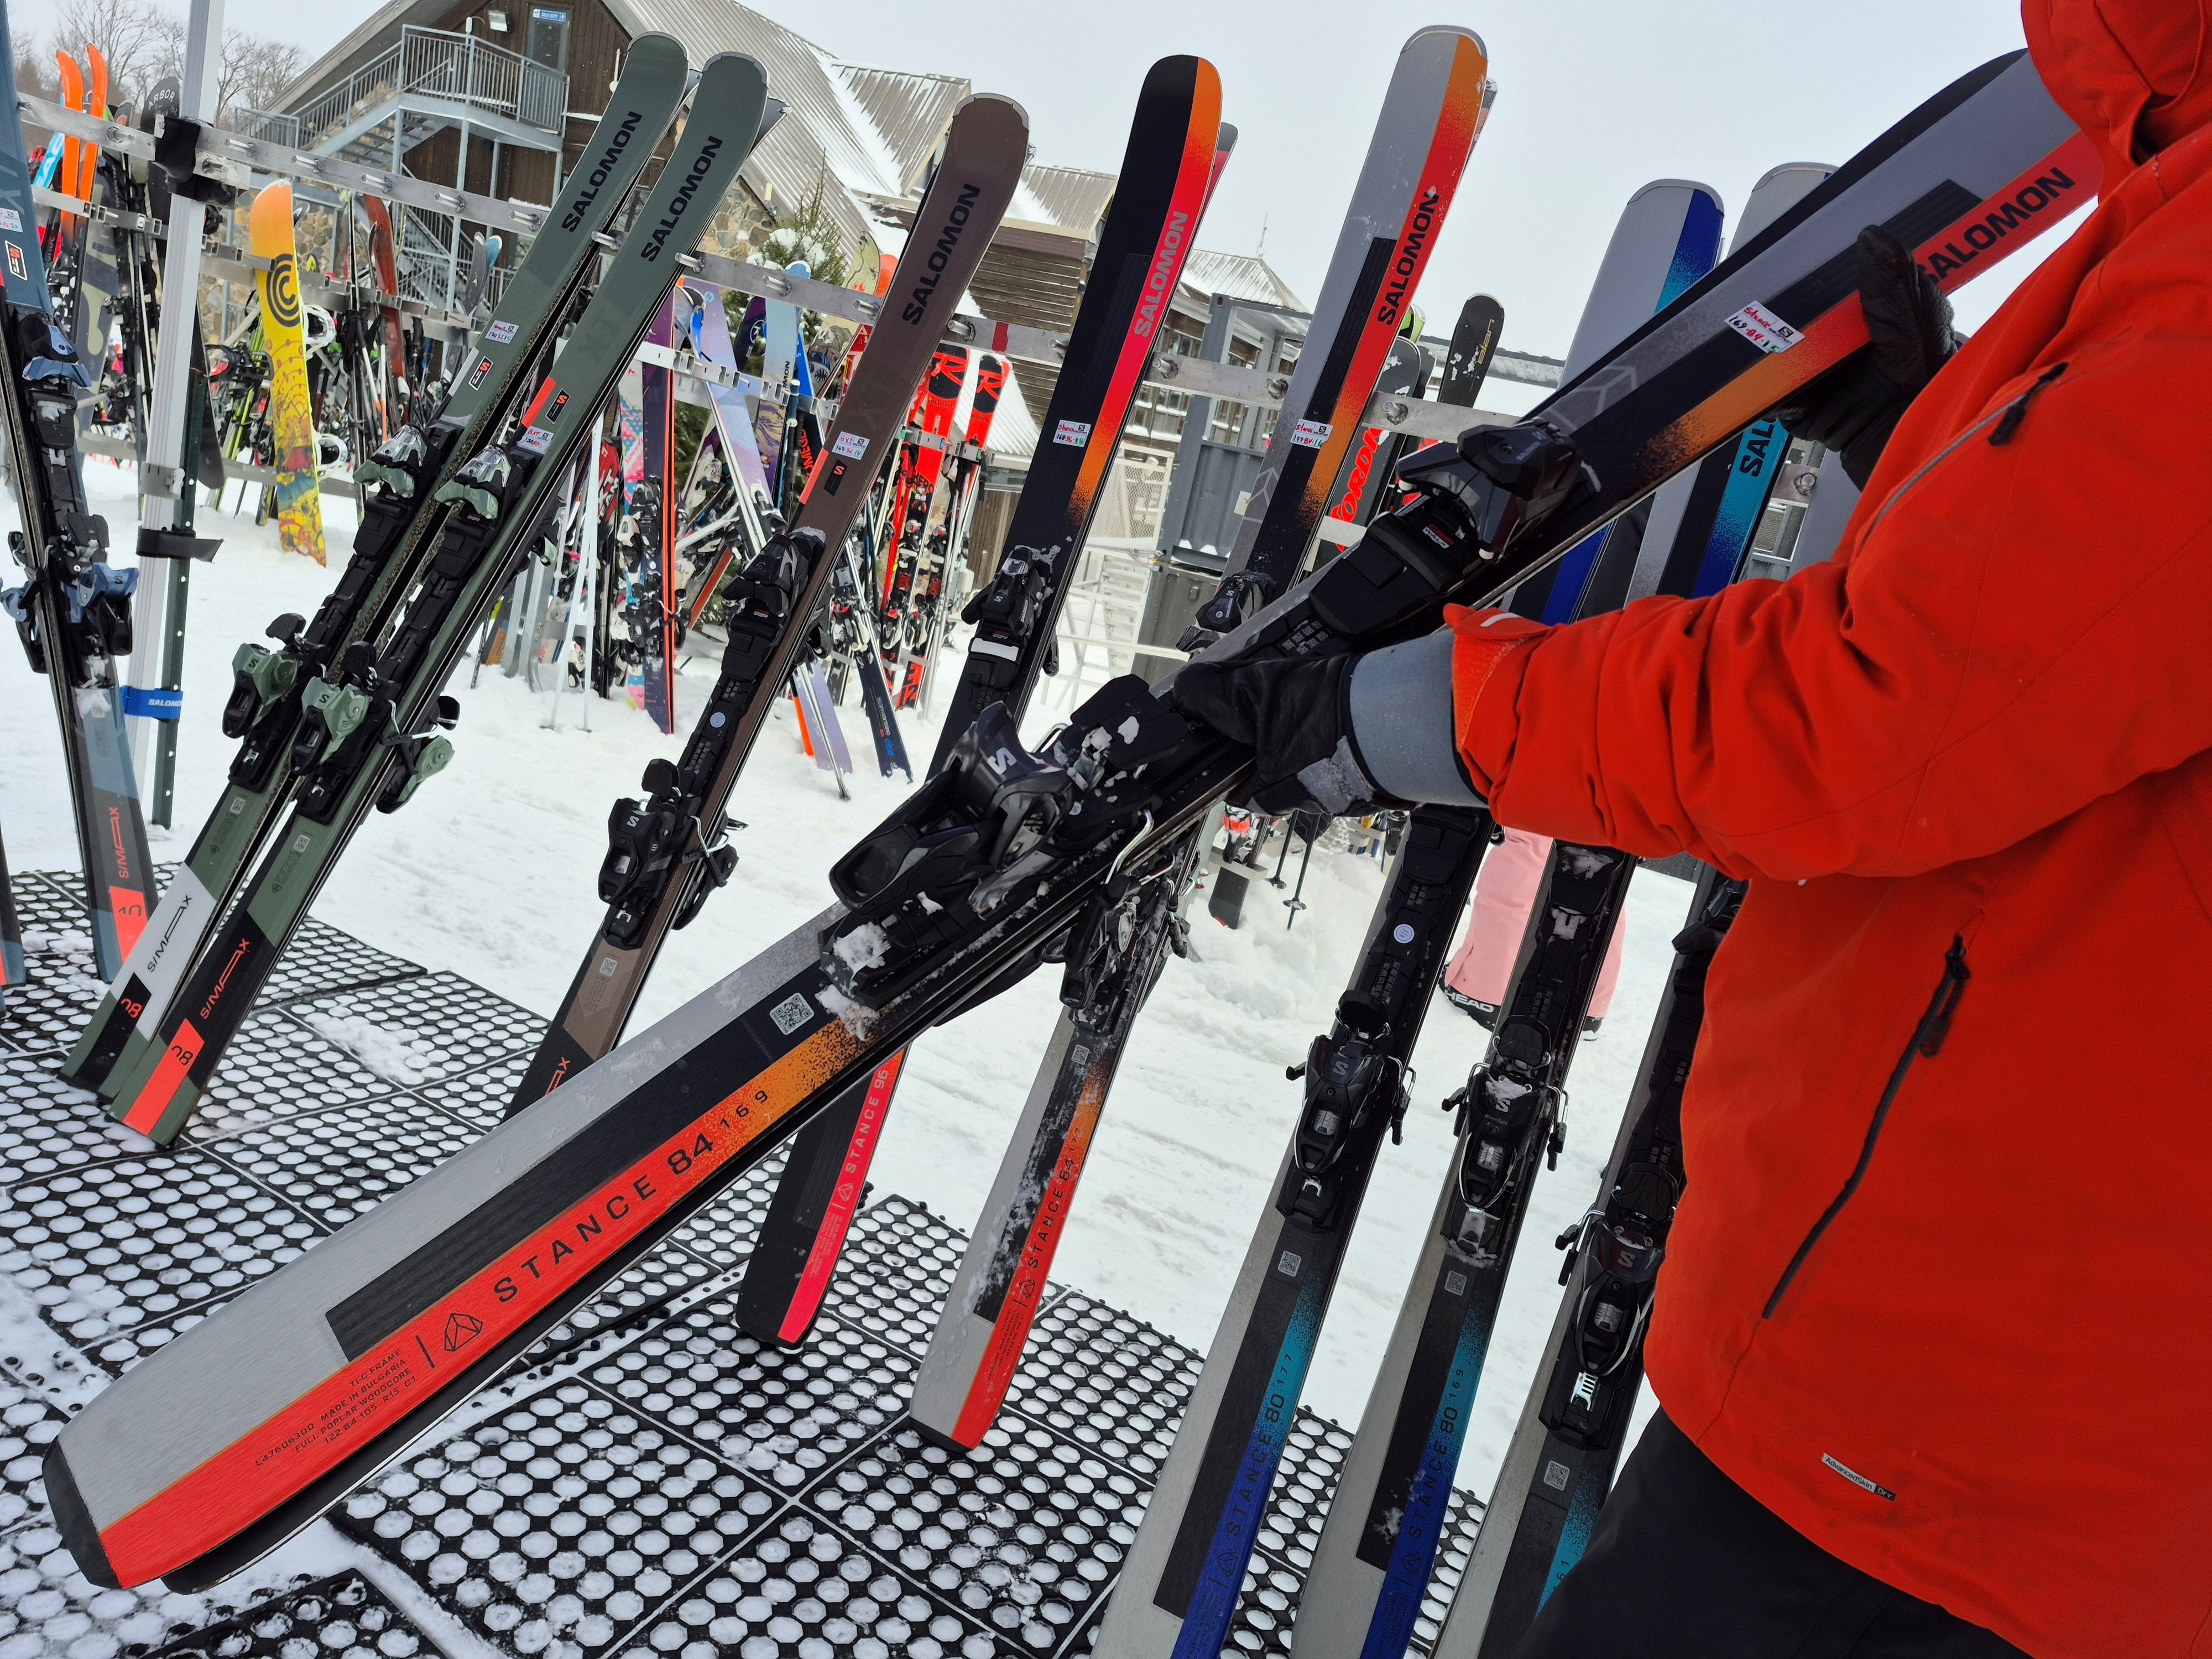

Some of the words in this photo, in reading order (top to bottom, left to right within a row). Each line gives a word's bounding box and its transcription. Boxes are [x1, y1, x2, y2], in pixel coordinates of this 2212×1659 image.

[148, 89, 176, 111] ARBOR
[562, 111, 643, 233] SALOMON
[640, 135, 723, 262] SALOMON
[902, 183, 981, 326] SALOMON
[1134, 211, 1188, 337] SALOMON
[1377, 191, 1440, 326] SALOMON
[1477, 319, 1495, 366] elan
[928, 398, 953, 409] ROSSIGNOL
[971, 414, 990, 423] ROSSIGNOL
[1330, 427, 1384, 534] ORDI
[148, 698, 182, 707] SALOMO
[1444, 989, 1494, 1013] HEAD
[844, 1096, 880, 1174] STANCE
[874, 1068, 889, 1089] 96
[492, 1175, 657, 1303] STANCE
[667, 1133, 714, 1176] 84
[719, 1089, 769, 1128] 169
[1027, 1189, 1065, 1270] STANCE
[1059, 1158, 1074, 1182] 84
[319, 1400, 348, 1422] MADE
[348, 1391, 359, 1402] IN
[359, 1359, 407, 1392] BULGARIA
[368, 1349, 402, 1374] FRAME
[294, 1433, 319, 1452] FULL
[319, 1406, 359, 1434] POPLAR
[358, 1368, 413, 1407] WOODCORE
[323, 1429, 342, 1444] 122
[342, 1418, 358, 1430] 84
[359, 1404, 378, 1419] 105
[382, 1387, 400, 1403] R15
[1226, 1431, 1273, 1538] STANCE
[1265, 1394, 1285, 1423] 80
[1276, 1353, 1293, 1385] 177
[1408, 1442, 1448, 1541] STANCE
[1439, 1405, 1458, 1434] 80
[1449, 1369, 1465, 1400] 169
[1825, 1458, 1872, 1490] AdvancedSkin
[1877, 1488, 1892, 1499] Dry
